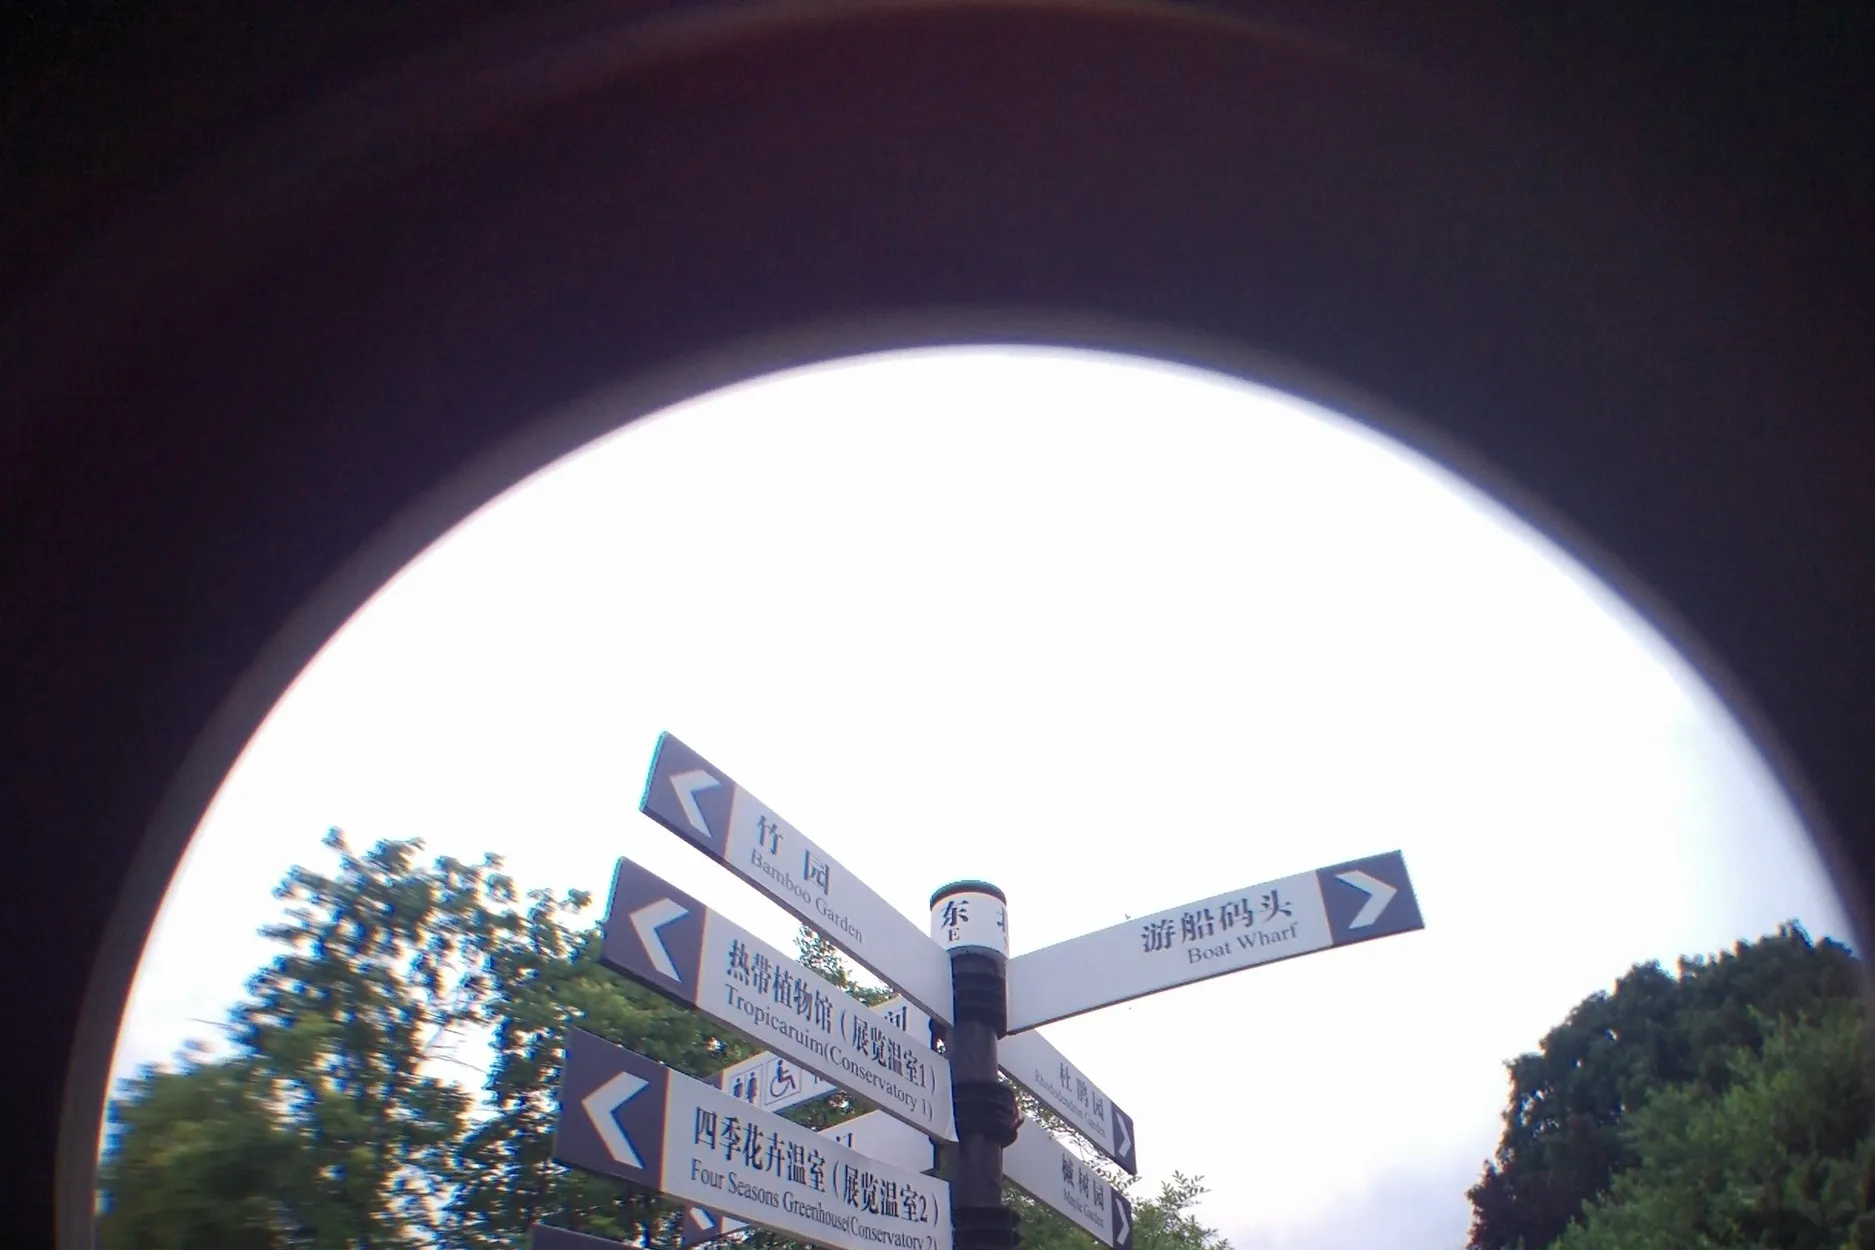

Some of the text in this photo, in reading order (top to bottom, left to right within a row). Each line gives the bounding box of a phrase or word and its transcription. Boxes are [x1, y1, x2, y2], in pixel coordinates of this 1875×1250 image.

[757, 815, 831, 896] 竹园
[751, 848, 863, 943] Bamboo Garden
[941, 900, 969, 930] 东
[948, 927, 960, 942] E
[1141, 890, 1293, 953] 游船码头
[1188, 921, 1299, 964] Boat Wharf
[691, 1157, 724, 1189] Four
[728, 1171, 780, 1208] Seasons
